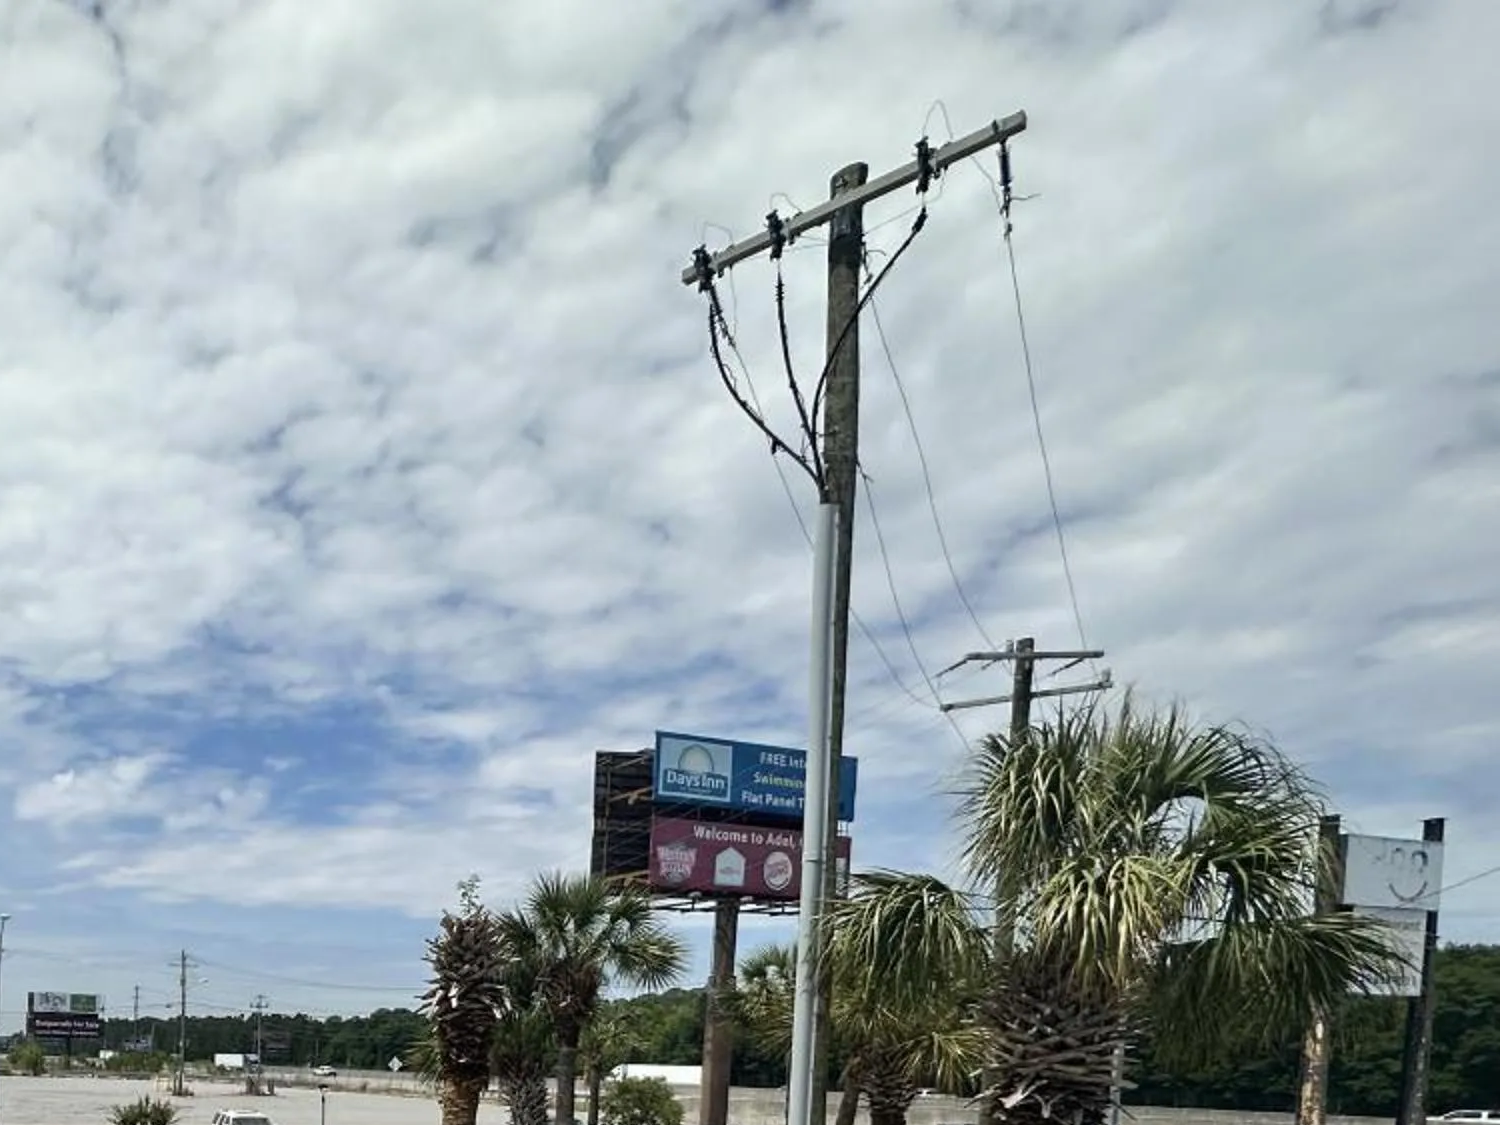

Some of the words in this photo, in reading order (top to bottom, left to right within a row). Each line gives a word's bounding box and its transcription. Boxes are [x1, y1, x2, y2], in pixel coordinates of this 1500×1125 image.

[760, 751, 787, 767] FREE
[789, 756, 804, 769] Int
[667, 769, 700, 788] Days
[701, 773, 725, 789] Inn
[753, 771, 804, 789] Swimmin
[766, 793, 795, 808] Panel
[693, 824, 749, 843] Welcome
[751, 831, 765, 845] to
